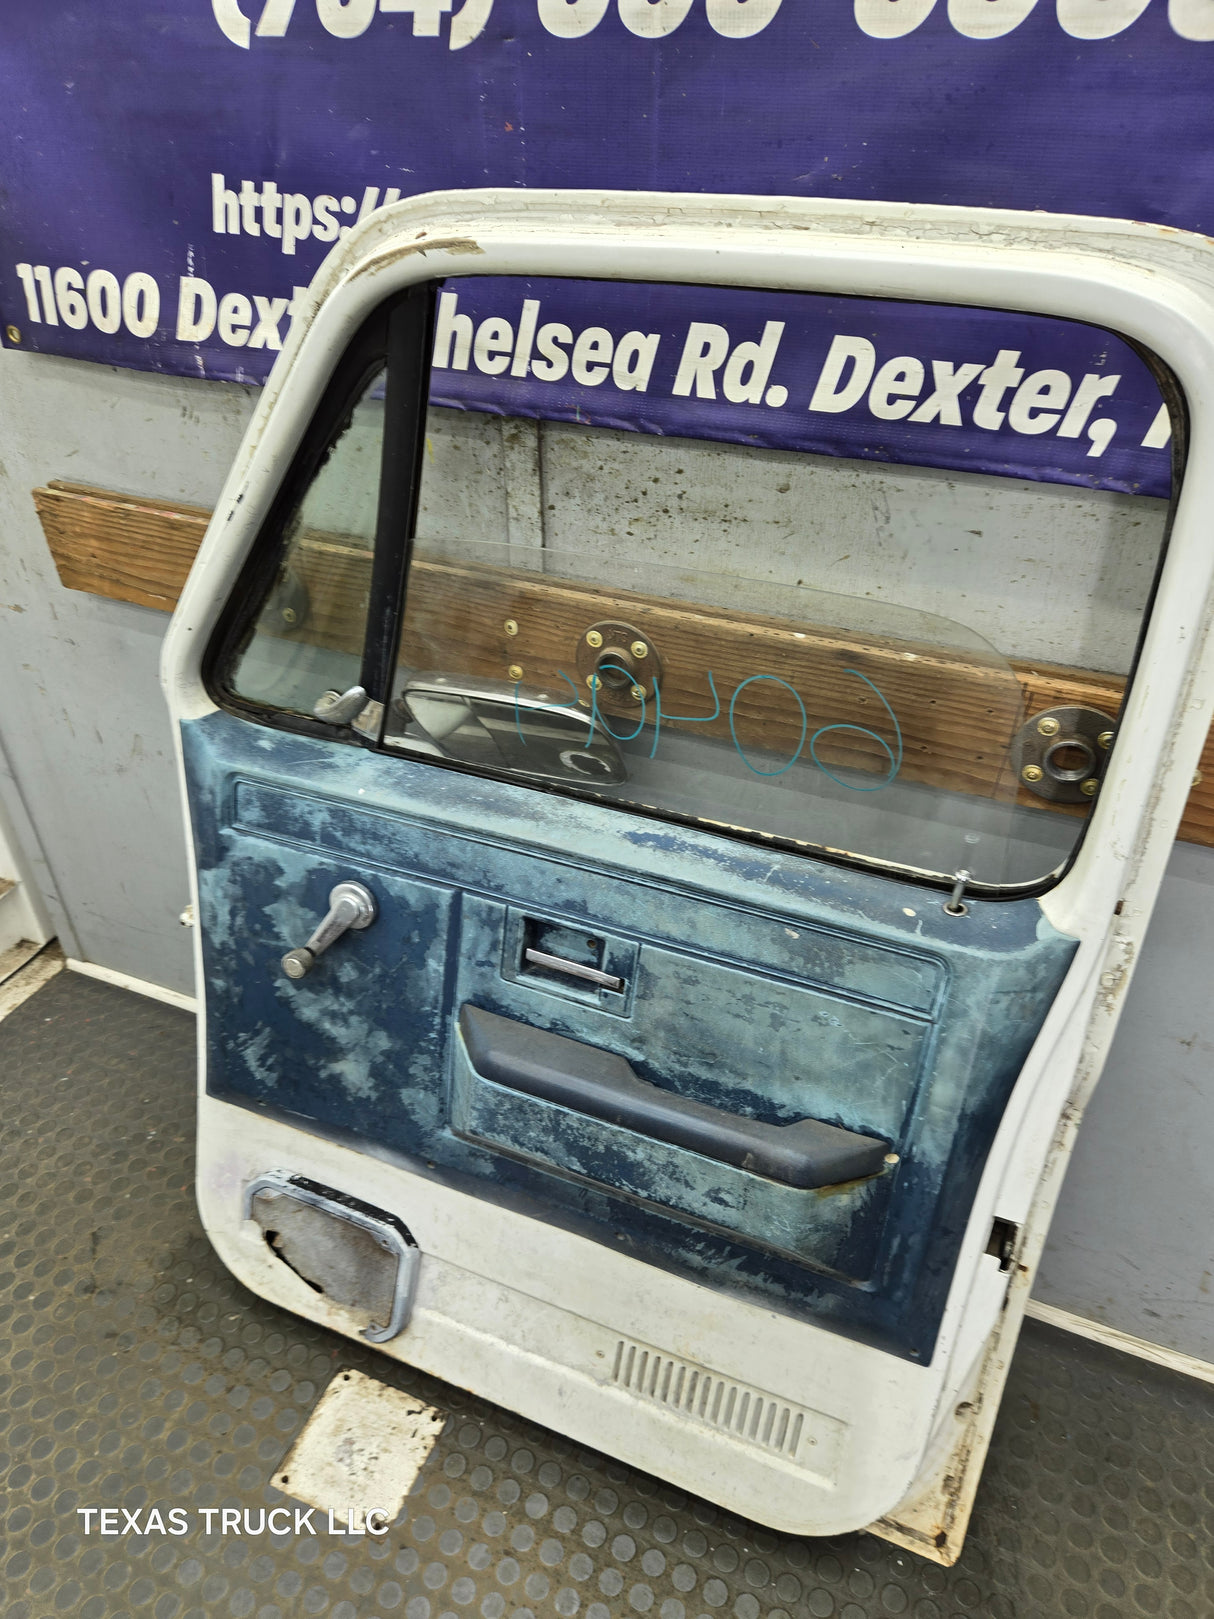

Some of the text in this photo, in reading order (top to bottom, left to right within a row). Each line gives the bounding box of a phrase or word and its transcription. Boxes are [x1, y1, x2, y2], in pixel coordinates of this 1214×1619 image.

[16, 263, 160, 338] 11600
[433, 292, 660, 392] helsea
[672, 320, 789, 408] Rd.
[809, 335, 1121, 457] Dexter,
